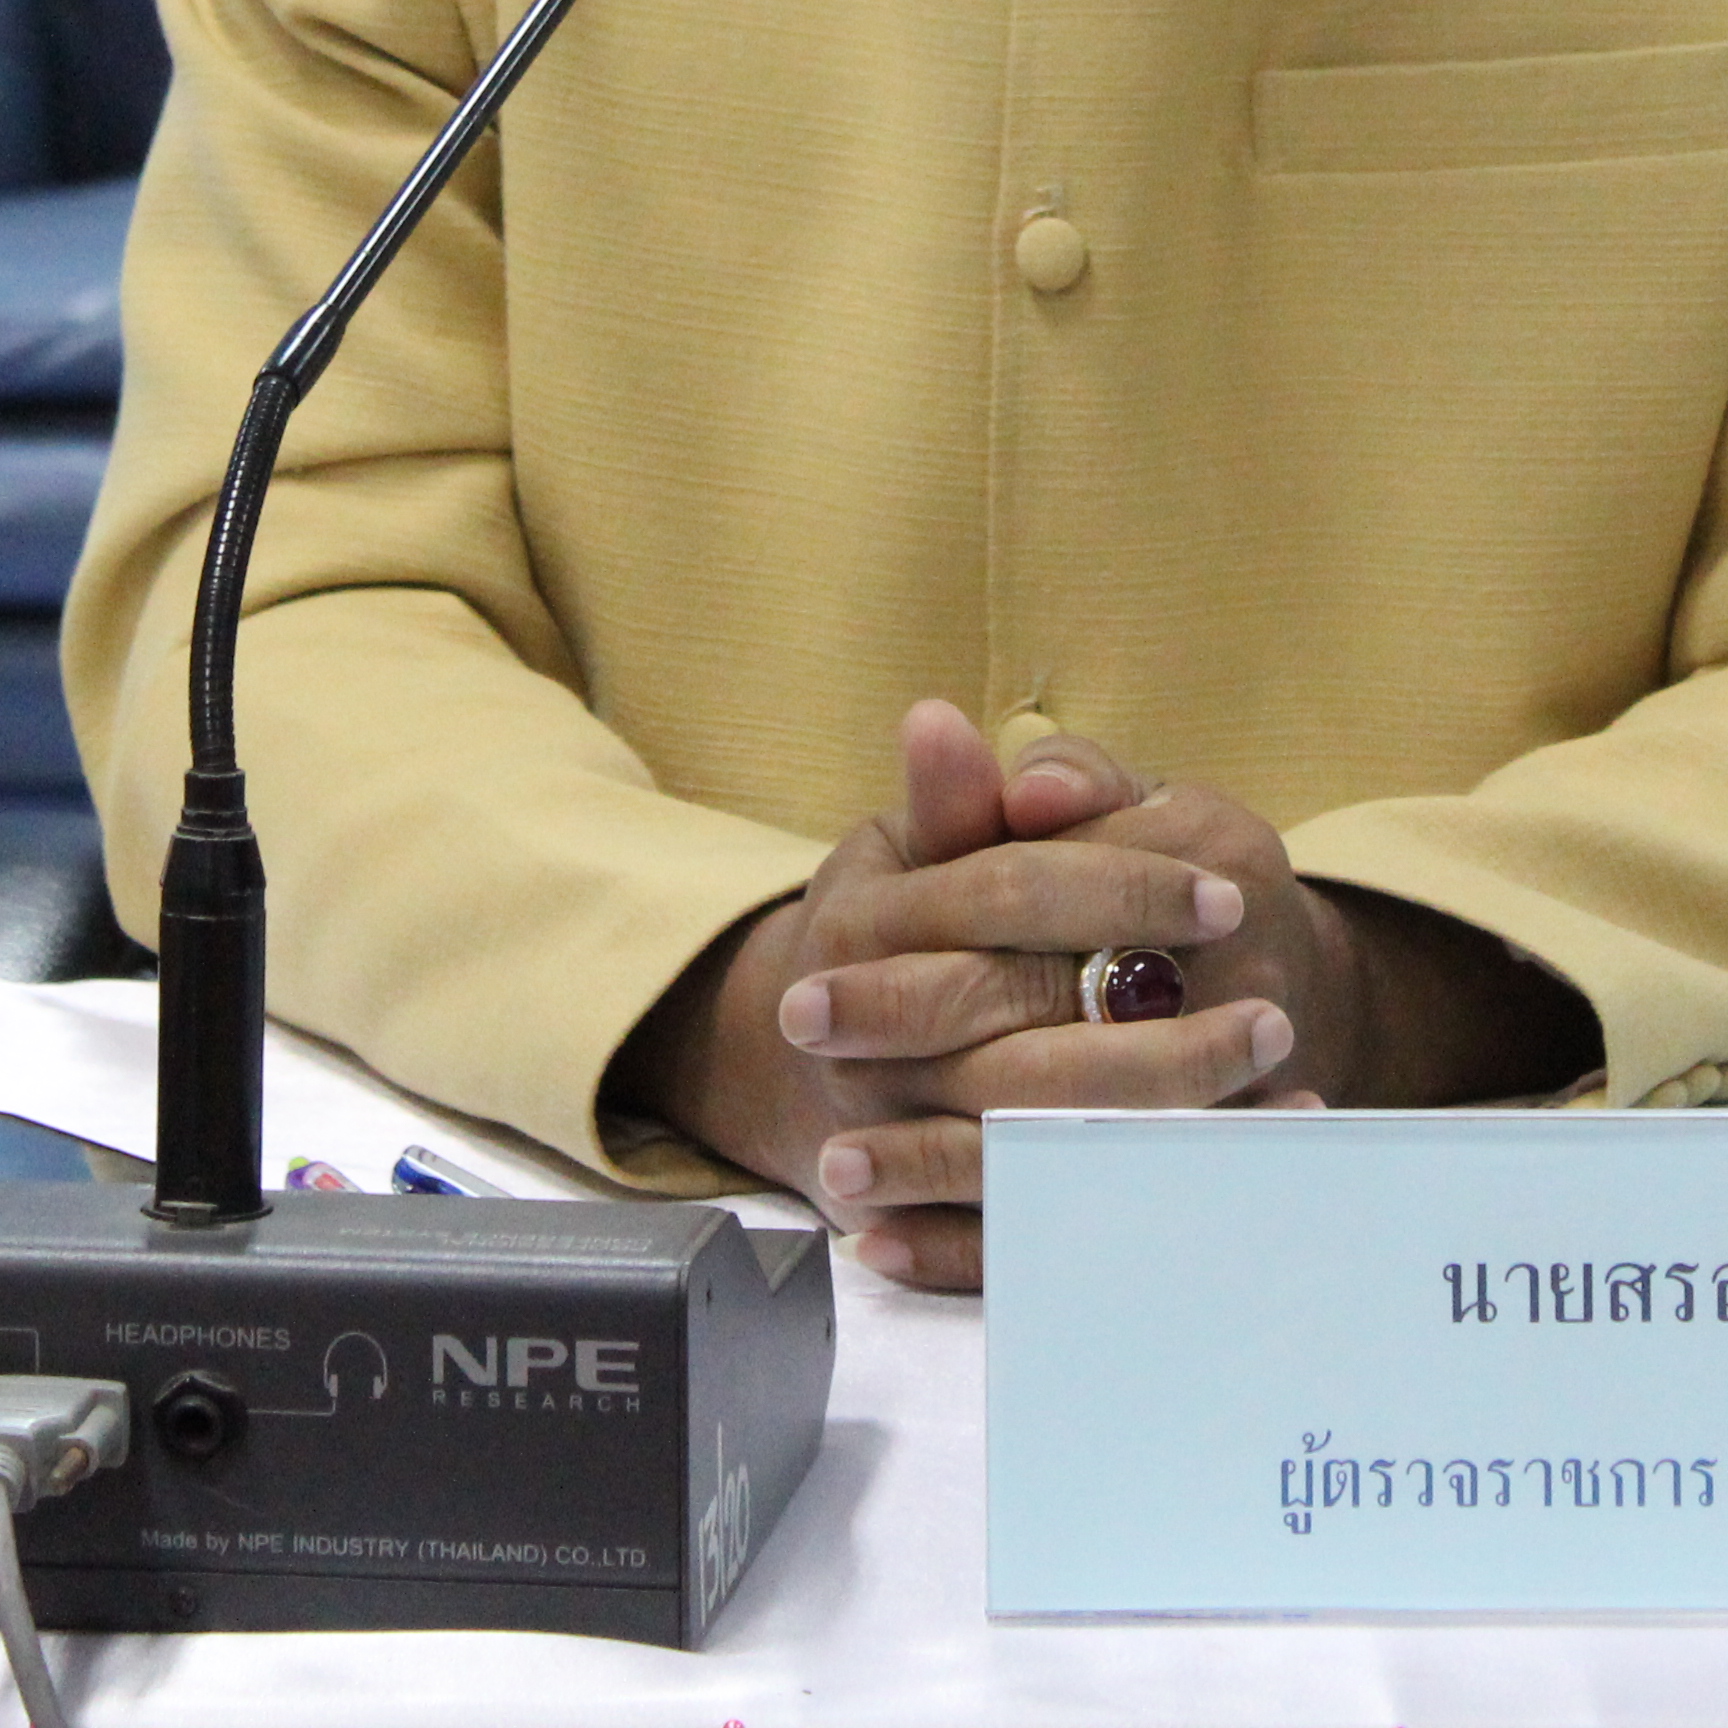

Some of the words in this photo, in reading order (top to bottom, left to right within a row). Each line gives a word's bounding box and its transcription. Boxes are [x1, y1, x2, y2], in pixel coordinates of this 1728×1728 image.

[105, 1322, 292, 1352] HEADPHONES
[432, 1334, 640, 1393] NPE
[432, 1390, 640, 1413] RESEARCH
[140, 1528, 198, 1551] Made
[205, 1531, 230, 1556] by
[237, 1532, 283, 1554] NPE
[292, 1535, 410, 1559] INDUSTRY
[417, 1538, 548, 1566] (THAILAND)
